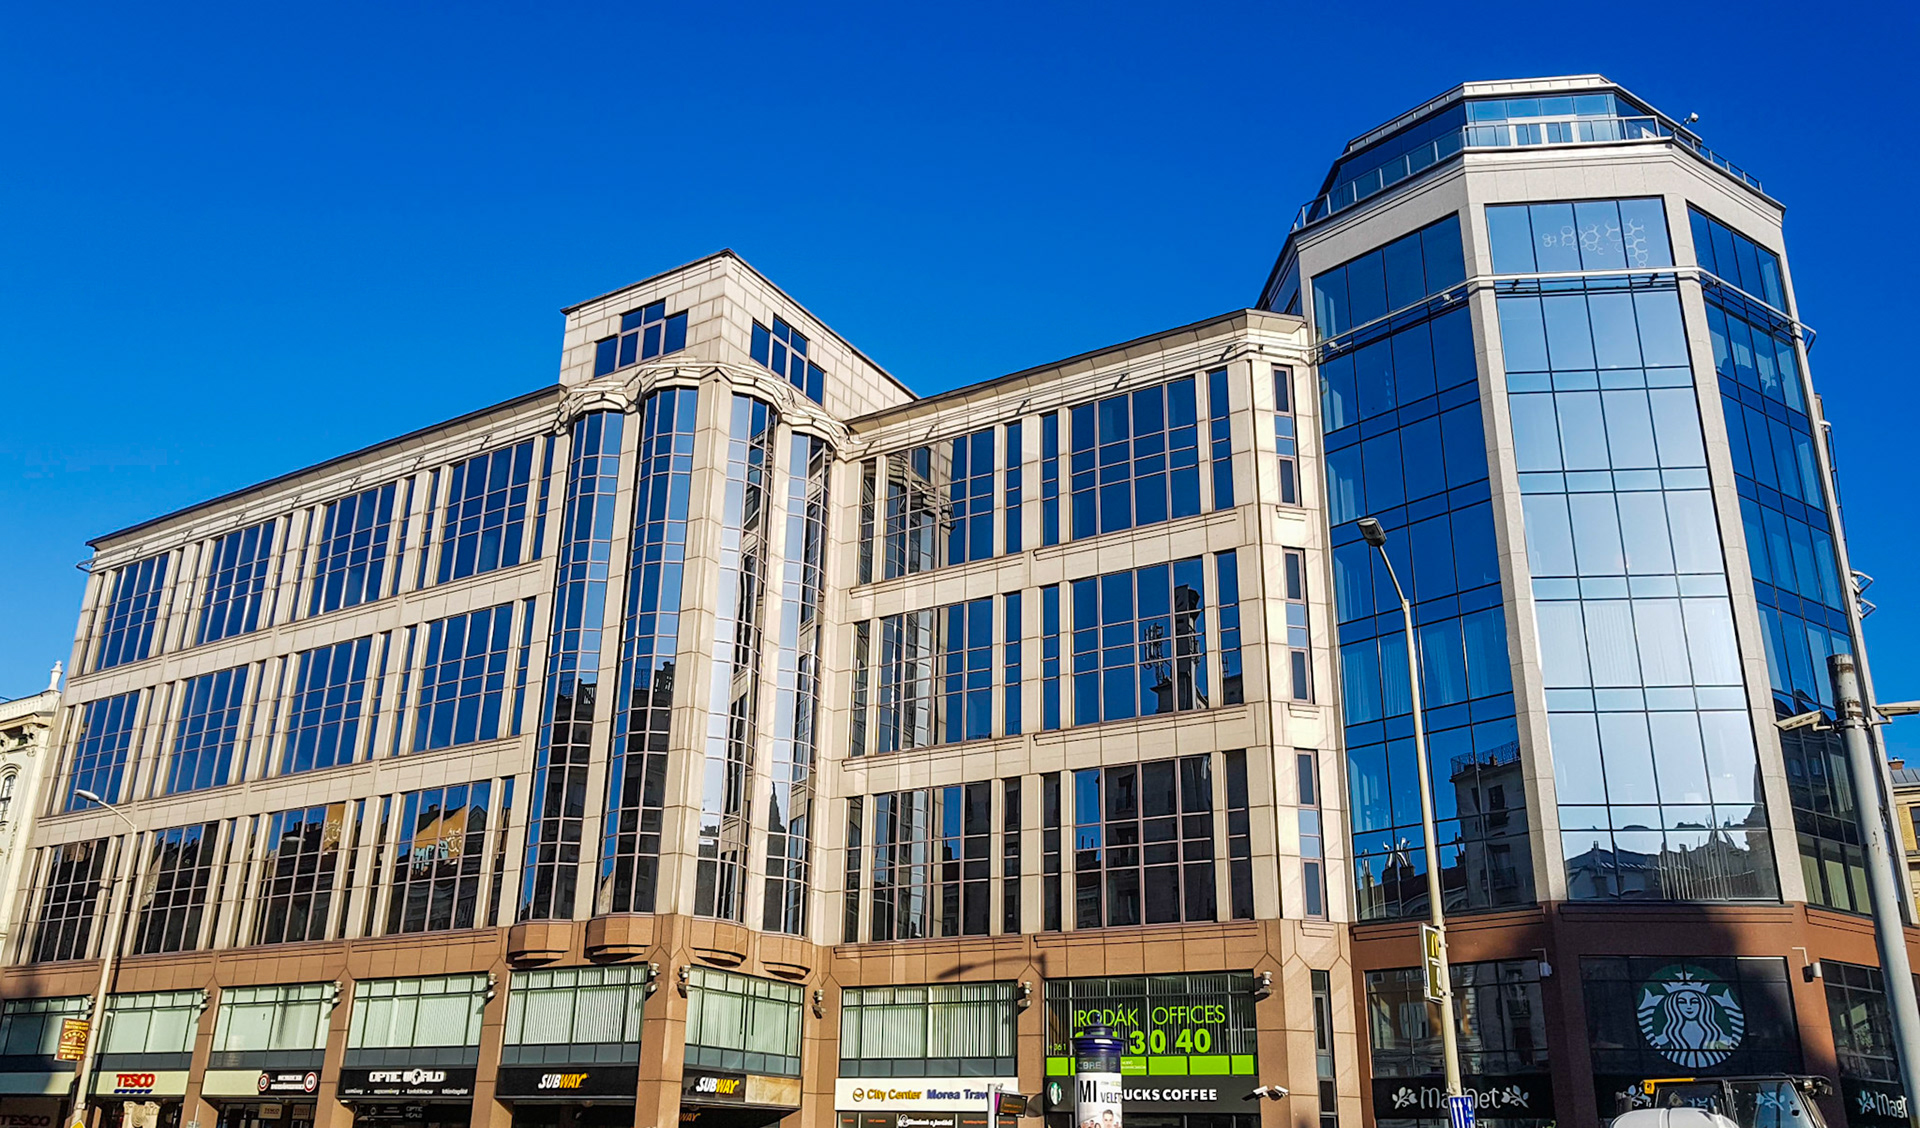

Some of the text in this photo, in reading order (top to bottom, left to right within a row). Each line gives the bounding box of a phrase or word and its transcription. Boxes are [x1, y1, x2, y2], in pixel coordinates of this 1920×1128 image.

[1073, 1003, 1226, 1028] IRODÁK OFFICES
[1129, 1028, 1211, 1055] 30 40
[116, 1073, 156, 1088] TESCO
[368, 1071, 402, 1083] OPTIC
[537, 1072, 588, 1089] SUBWAY
[695, 1076, 740, 1094] SUBWAY
[867, 1088, 988, 1102] City Center Morea Trav
[1079, 1080, 1097, 1103] MI
[1122, 1088, 1218, 1101] UCKS COFFEE
[1420, 1086, 1501, 1110] Manet
[679, 1112, 701, 1122] WAY
